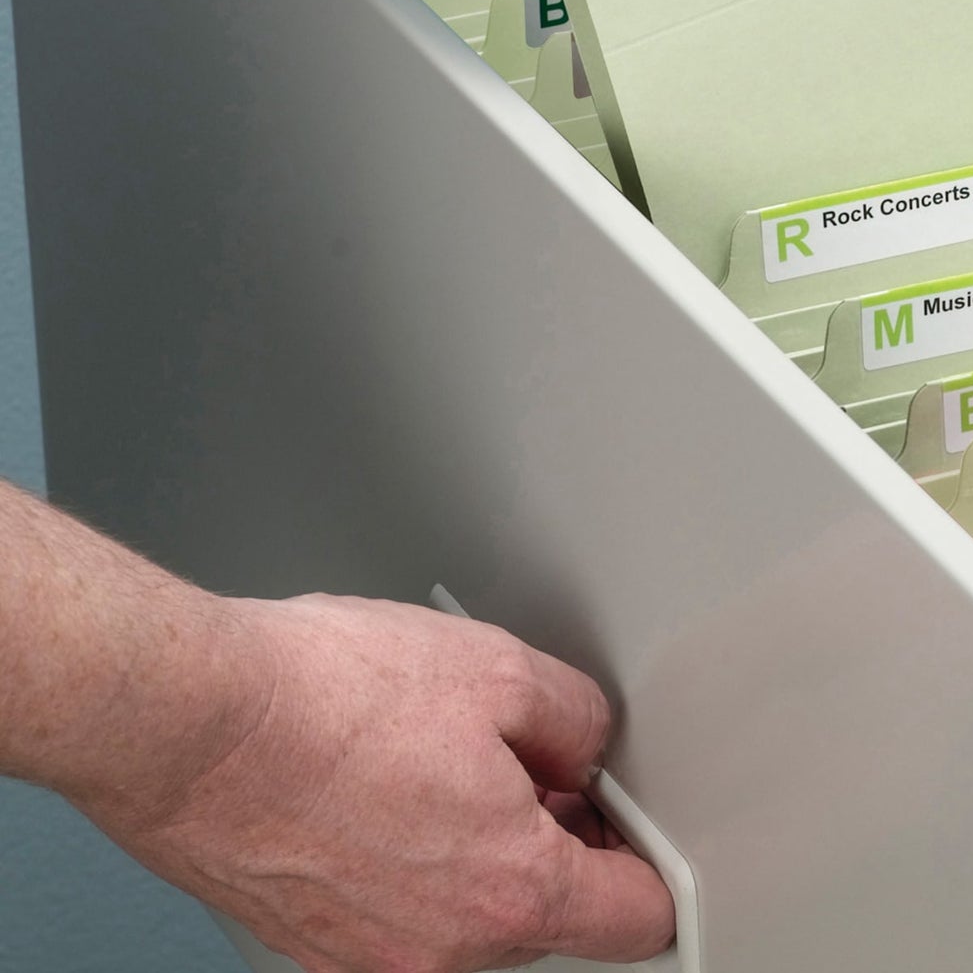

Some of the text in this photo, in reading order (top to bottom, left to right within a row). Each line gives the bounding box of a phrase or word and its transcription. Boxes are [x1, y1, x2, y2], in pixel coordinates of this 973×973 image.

[822, 184, 970, 228] Rock Concerts
[775, 218, 814, 263] R
[873, 305, 914, 350] M
